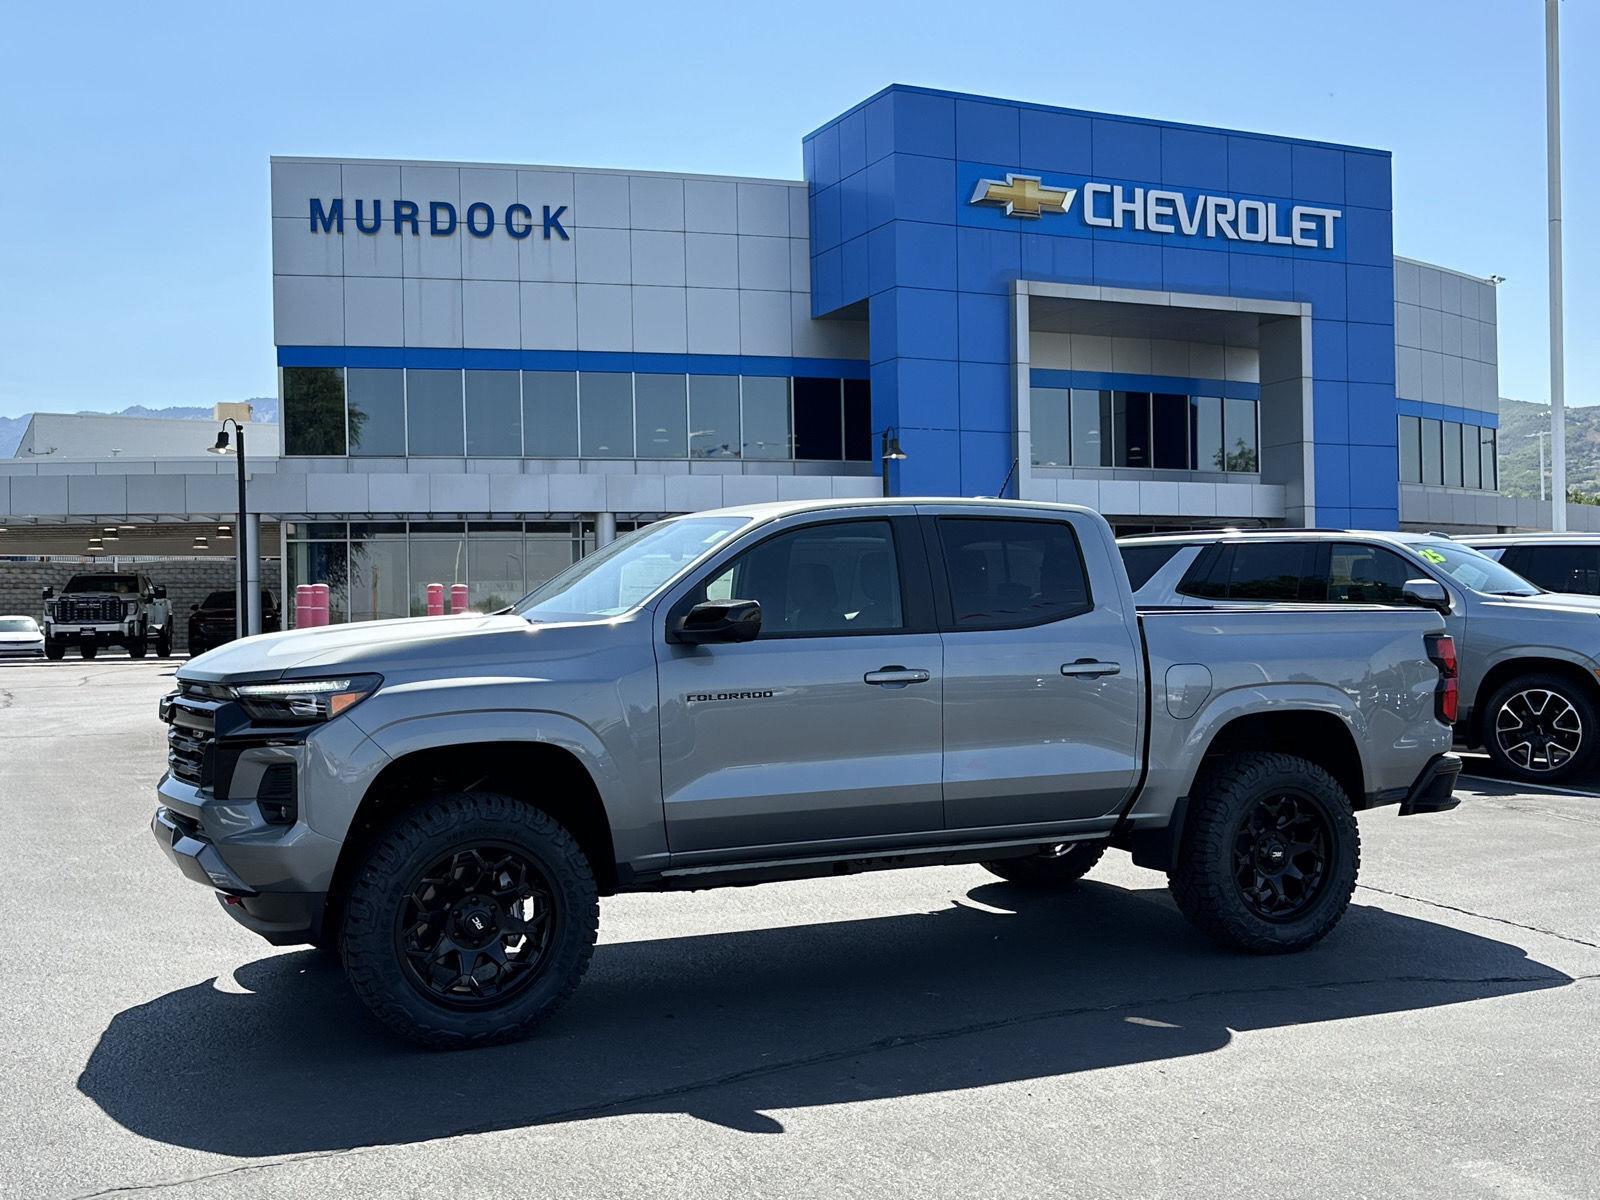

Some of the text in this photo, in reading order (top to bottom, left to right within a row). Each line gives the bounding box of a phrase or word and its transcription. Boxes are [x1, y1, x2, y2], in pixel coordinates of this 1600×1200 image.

[309, 198, 570, 241] MURDOCK
[1082, 182, 1342, 249] CHEVROLET
[686, 690, 773, 702] COLORADO
